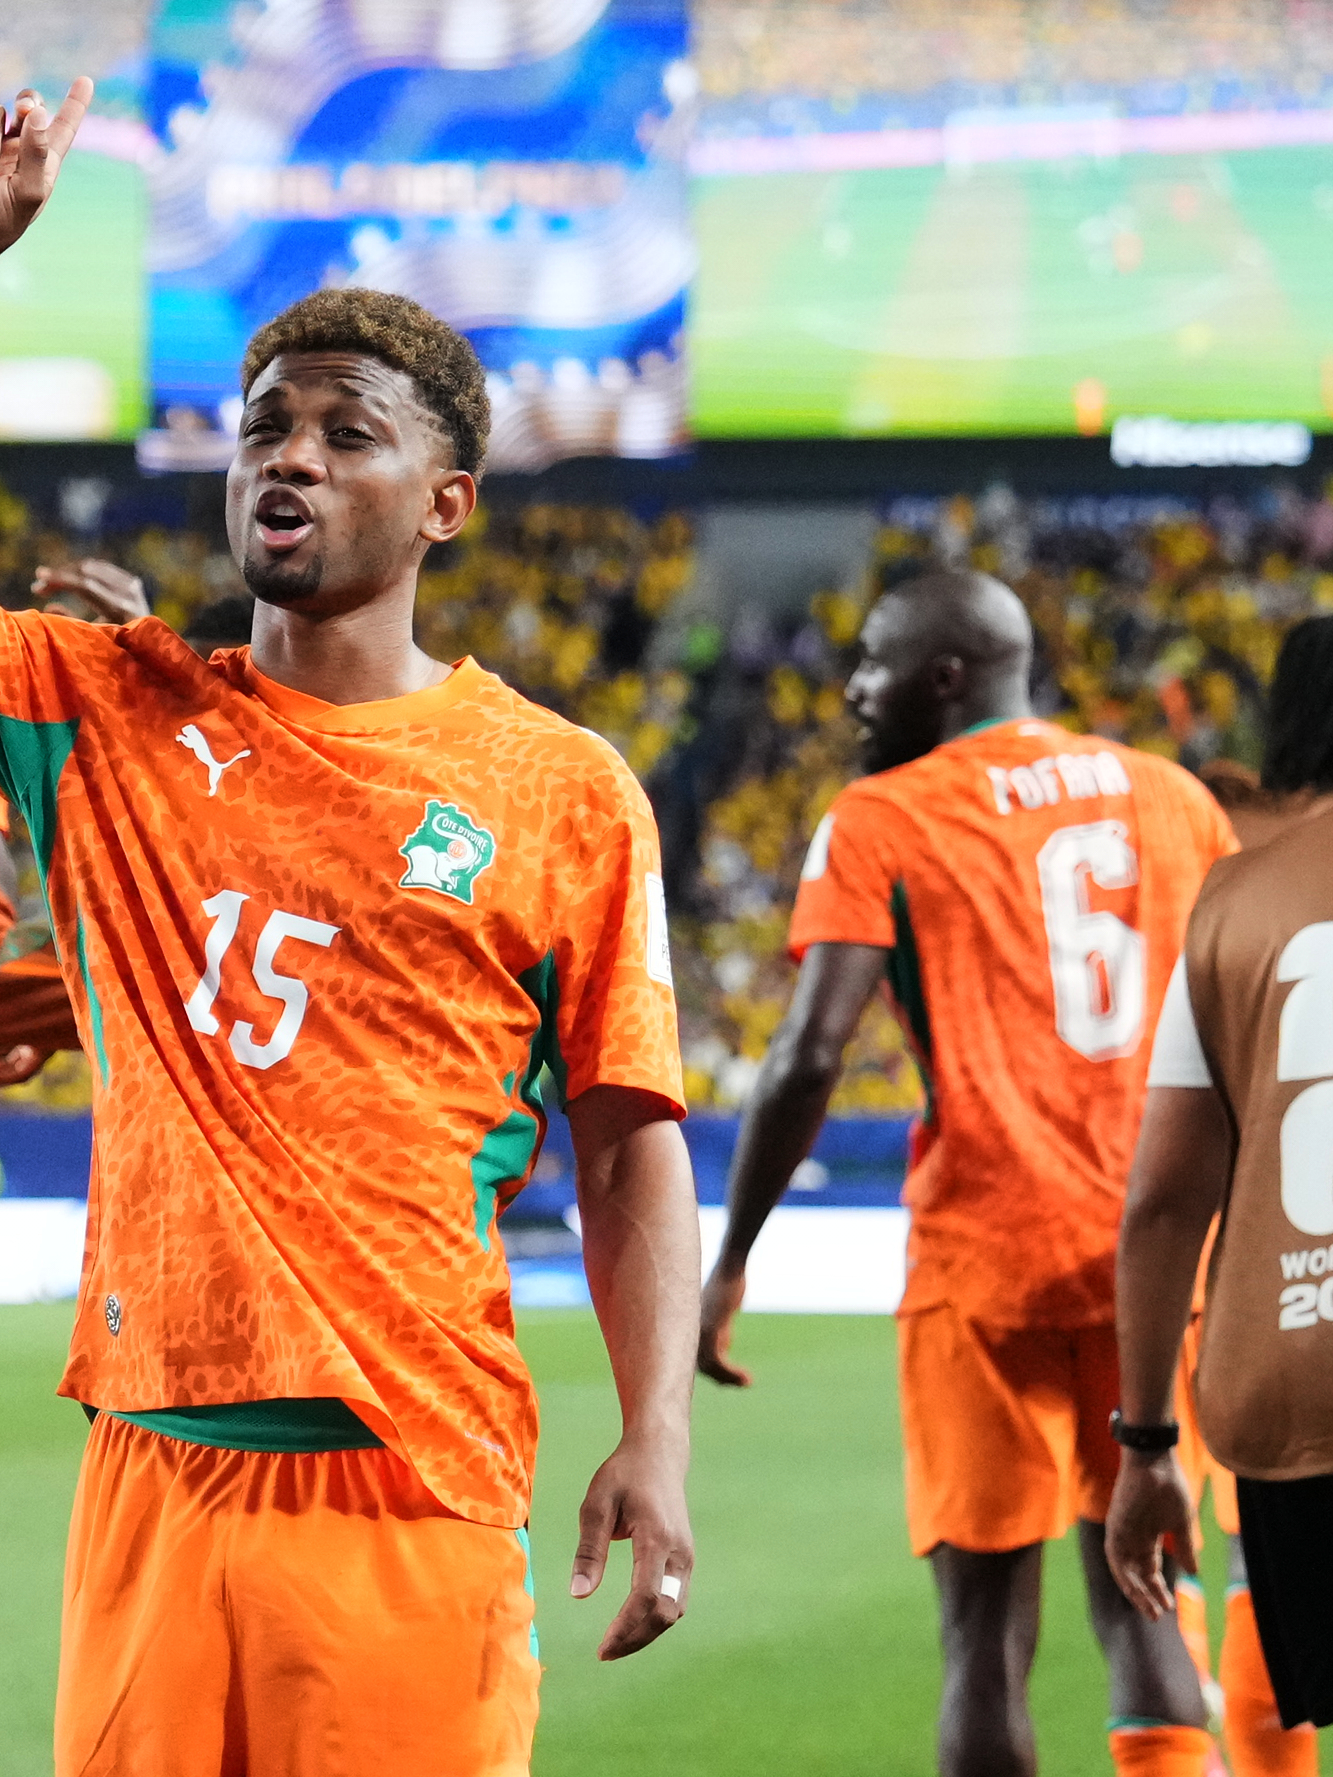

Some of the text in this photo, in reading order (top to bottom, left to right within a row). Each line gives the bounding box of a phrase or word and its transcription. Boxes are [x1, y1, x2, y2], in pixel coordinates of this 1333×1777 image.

[183, 889, 343, 1071] 15
[1036, 819, 1147, 1062] 6
[1280, 1244, 1333, 1280] WO
